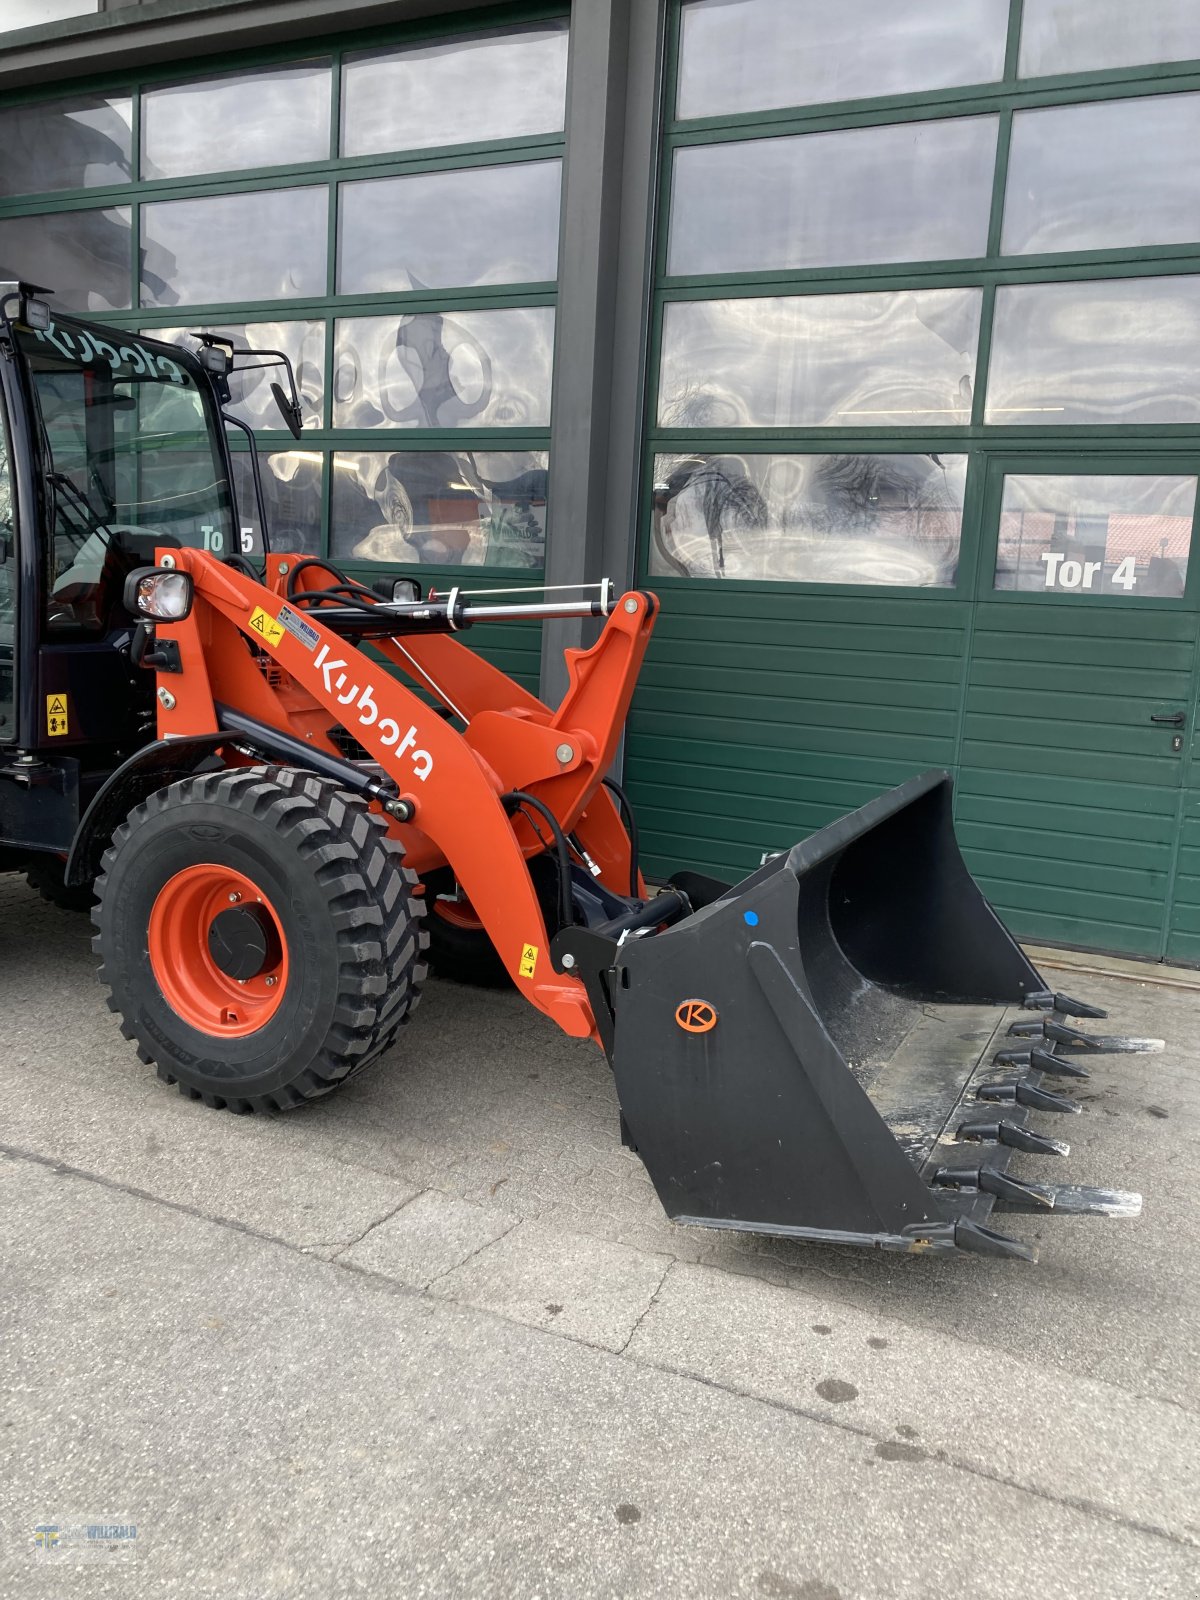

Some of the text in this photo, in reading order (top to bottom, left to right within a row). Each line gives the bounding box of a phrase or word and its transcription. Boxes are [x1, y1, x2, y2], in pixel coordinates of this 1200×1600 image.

[34, 322, 184, 384] Kubota
[201, 525, 253, 553] To 5
[1041, 552, 1137, 590] Tor 4
[313, 644, 434, 782] Kubota
